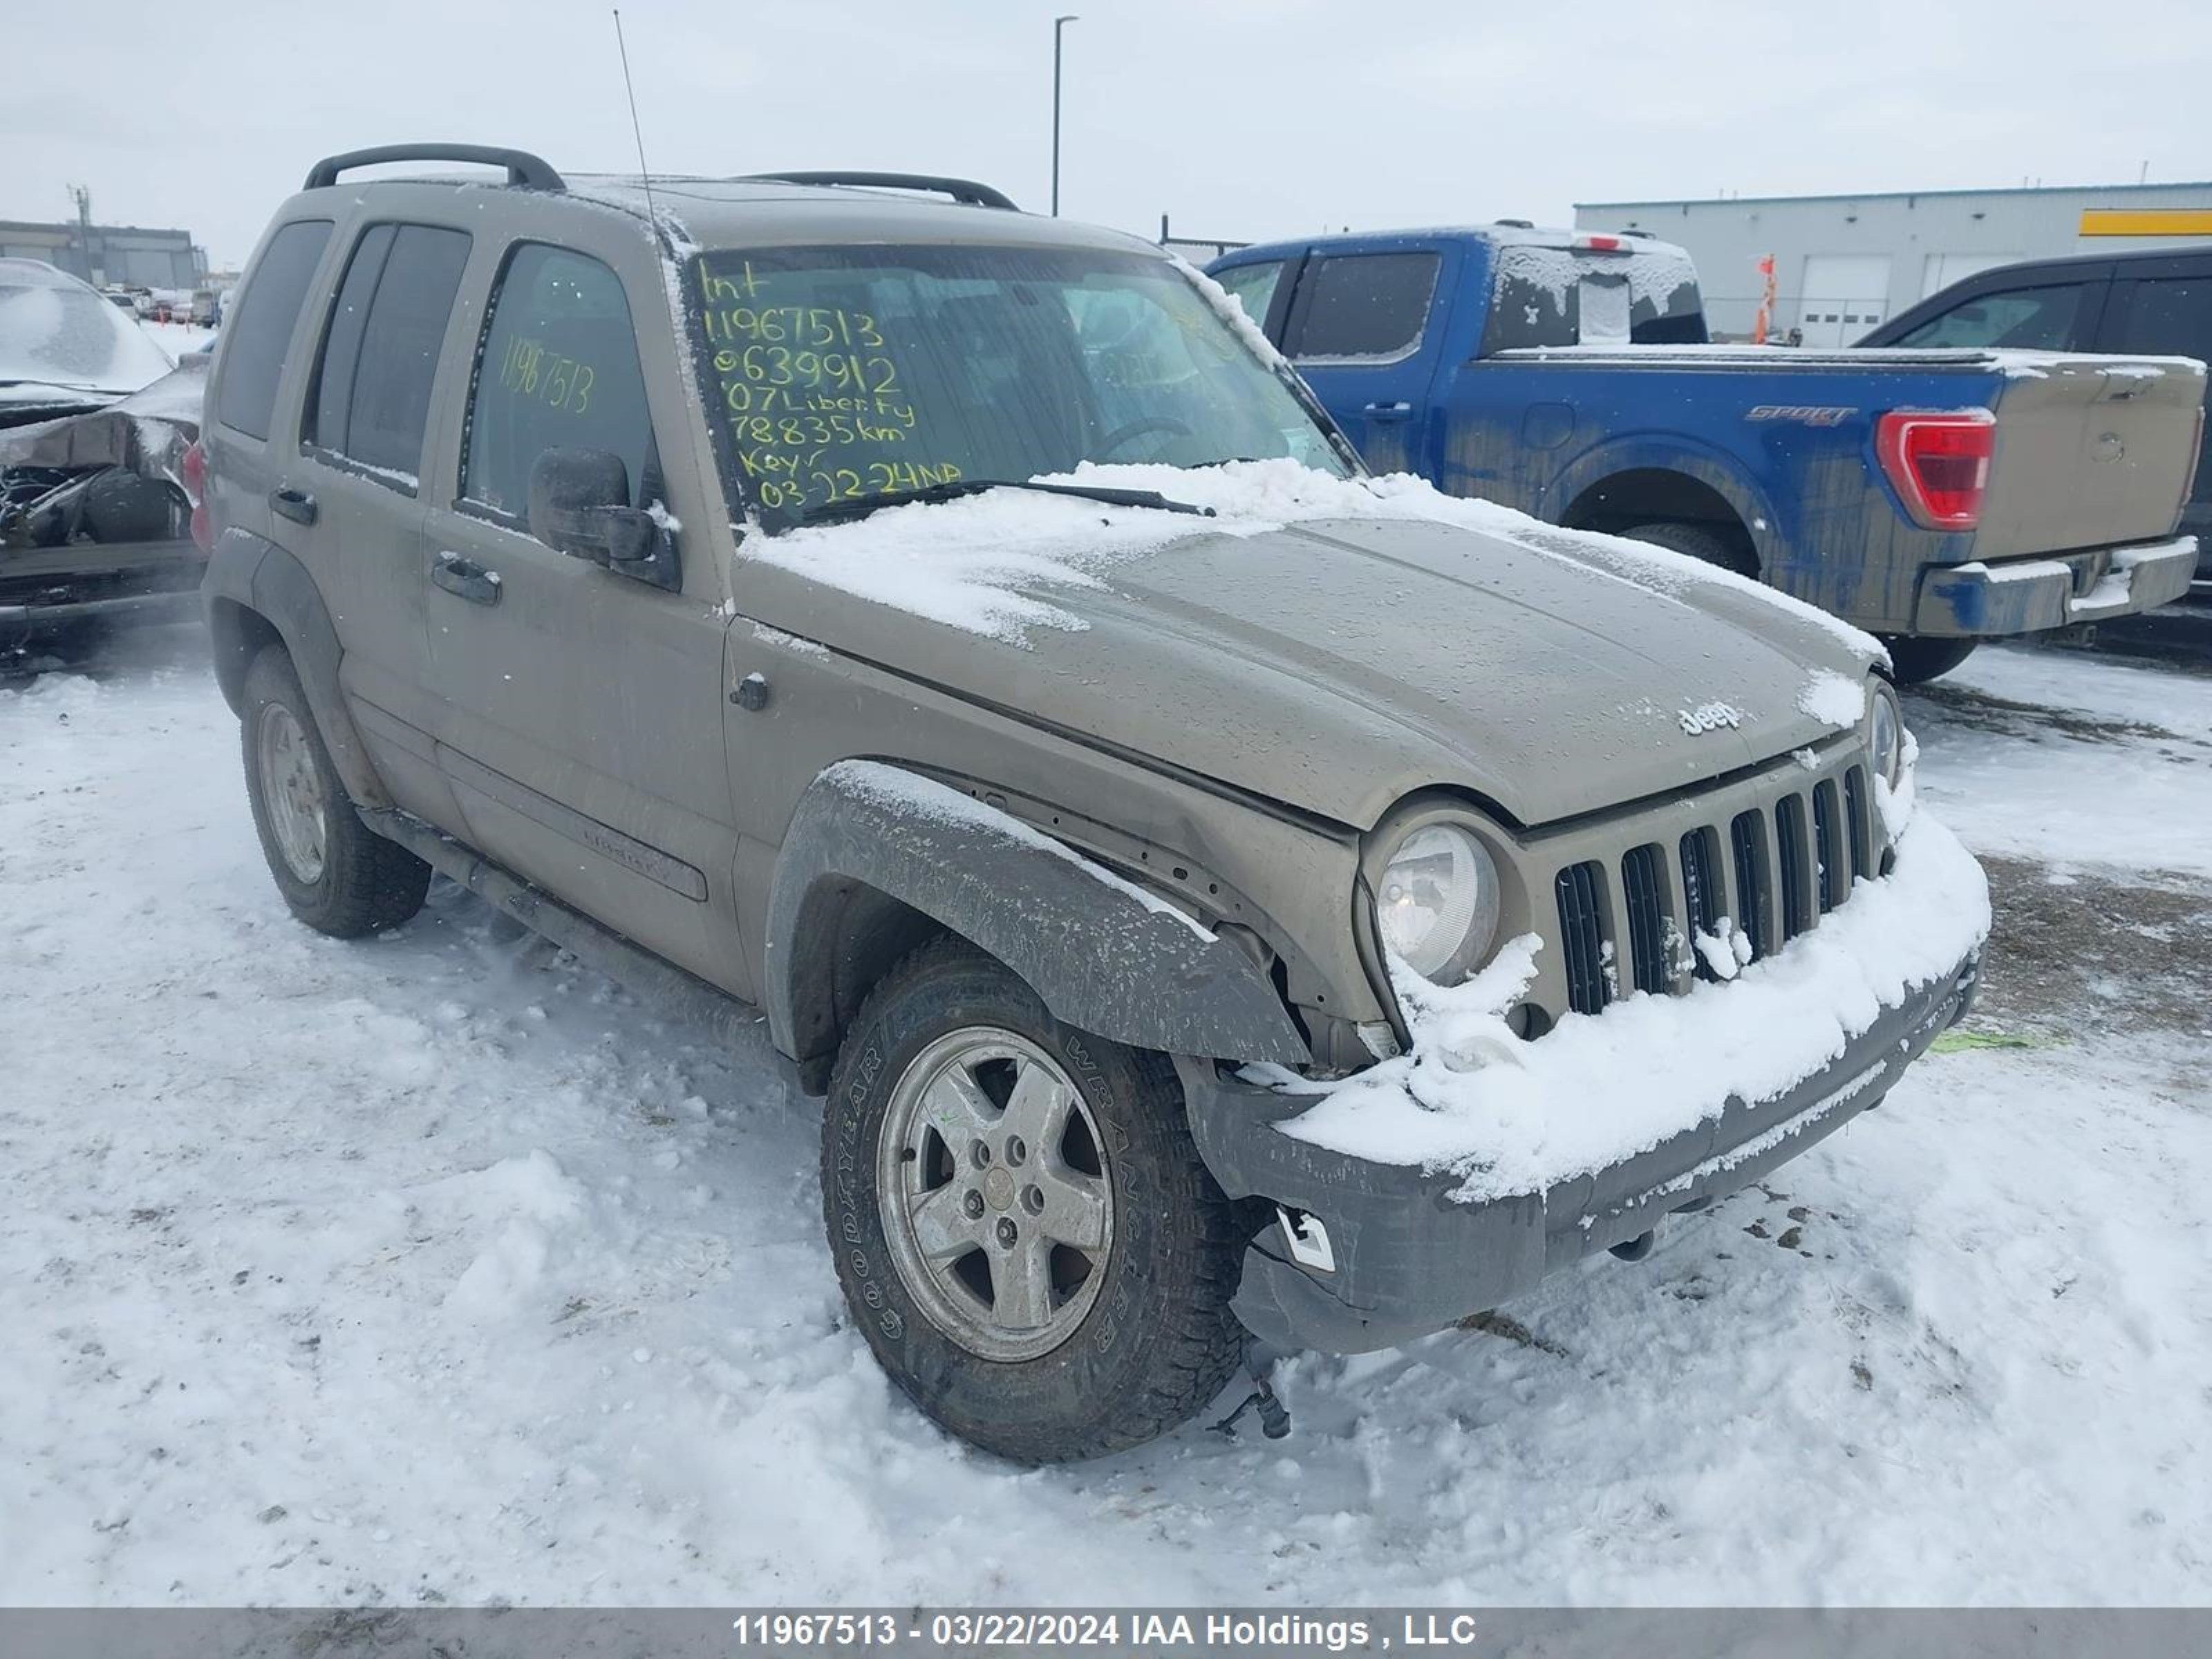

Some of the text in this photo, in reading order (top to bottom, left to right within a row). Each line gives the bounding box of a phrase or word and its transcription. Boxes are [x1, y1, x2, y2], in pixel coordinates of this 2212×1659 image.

[704, 308, 884, 346] 11967513
[499, 333, 594, 414] 11967513
[1744, 405, 1859, 427] SPORT
[738, 447, 800, 477] Key
[1677, 701, 1741, 736] Jeep
[838, 1046, 901, 1340] GOODYEAR
[1065, 1035, 1140, 1354] WRANGLER
